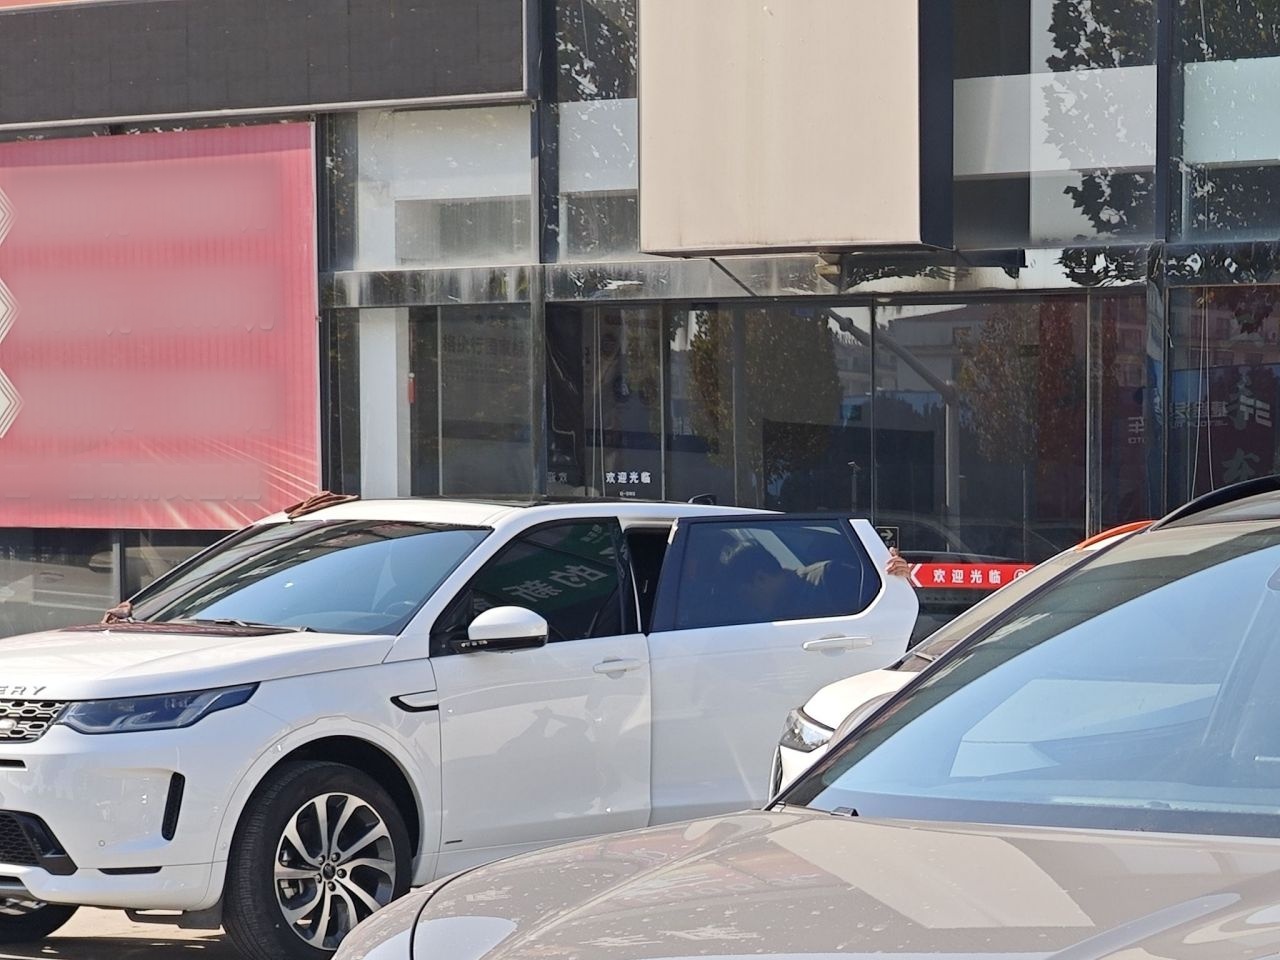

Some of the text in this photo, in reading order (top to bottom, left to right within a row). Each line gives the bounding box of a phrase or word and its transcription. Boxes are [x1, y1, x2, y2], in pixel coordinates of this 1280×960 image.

[605, 471, 651, 484] 欢迎光临
[933, 569, 1001, 584] 欢迎光临
